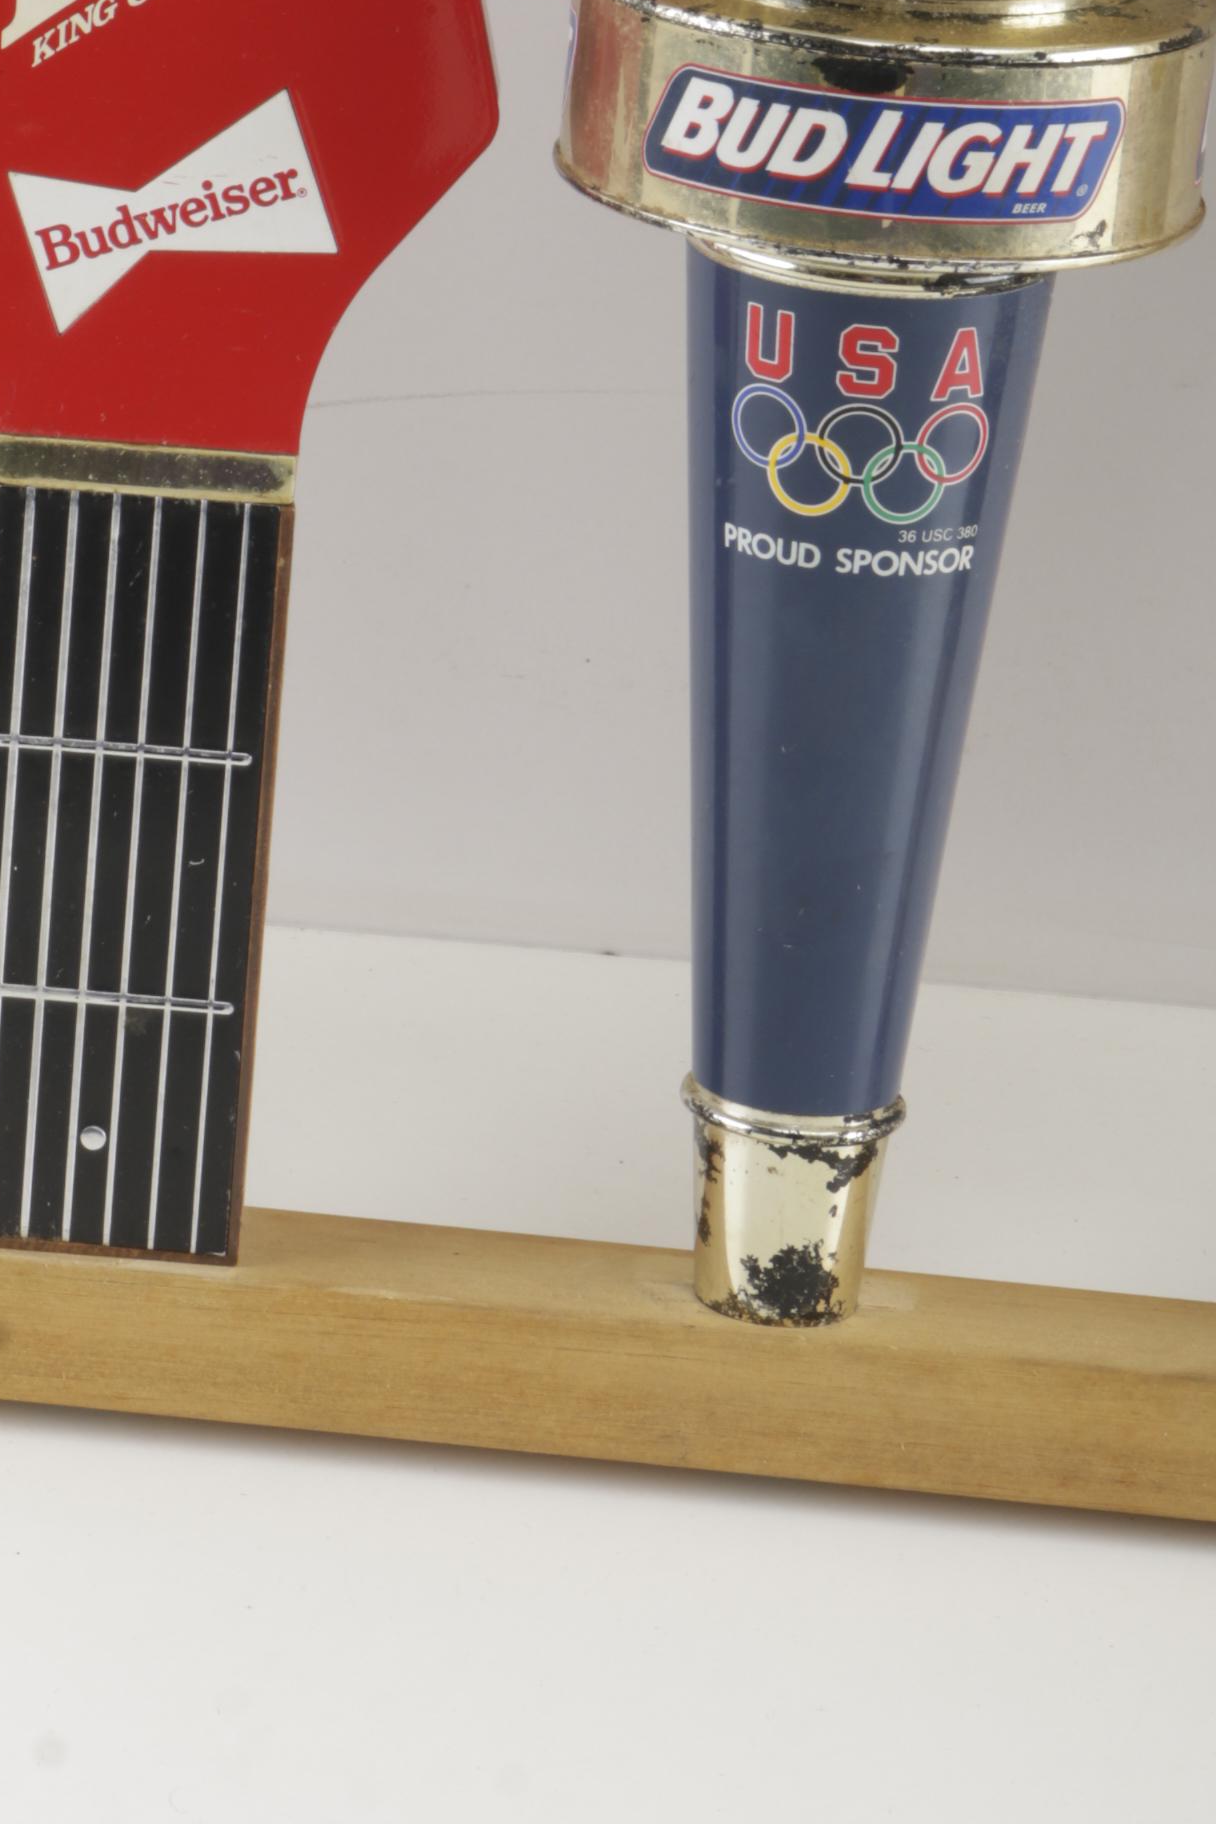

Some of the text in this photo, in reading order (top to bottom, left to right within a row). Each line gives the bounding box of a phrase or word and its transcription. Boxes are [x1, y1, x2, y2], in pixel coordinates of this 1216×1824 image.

[661, 77, 1109, 197] BUD LIGHT
[34, 167, 299, 271] Budweiser
[1011, 202, 1048, 214] BEER
[724, 521, 975, 577] PROUD SPONSOR
[897, 524, 978, 543] 36 USC 380
